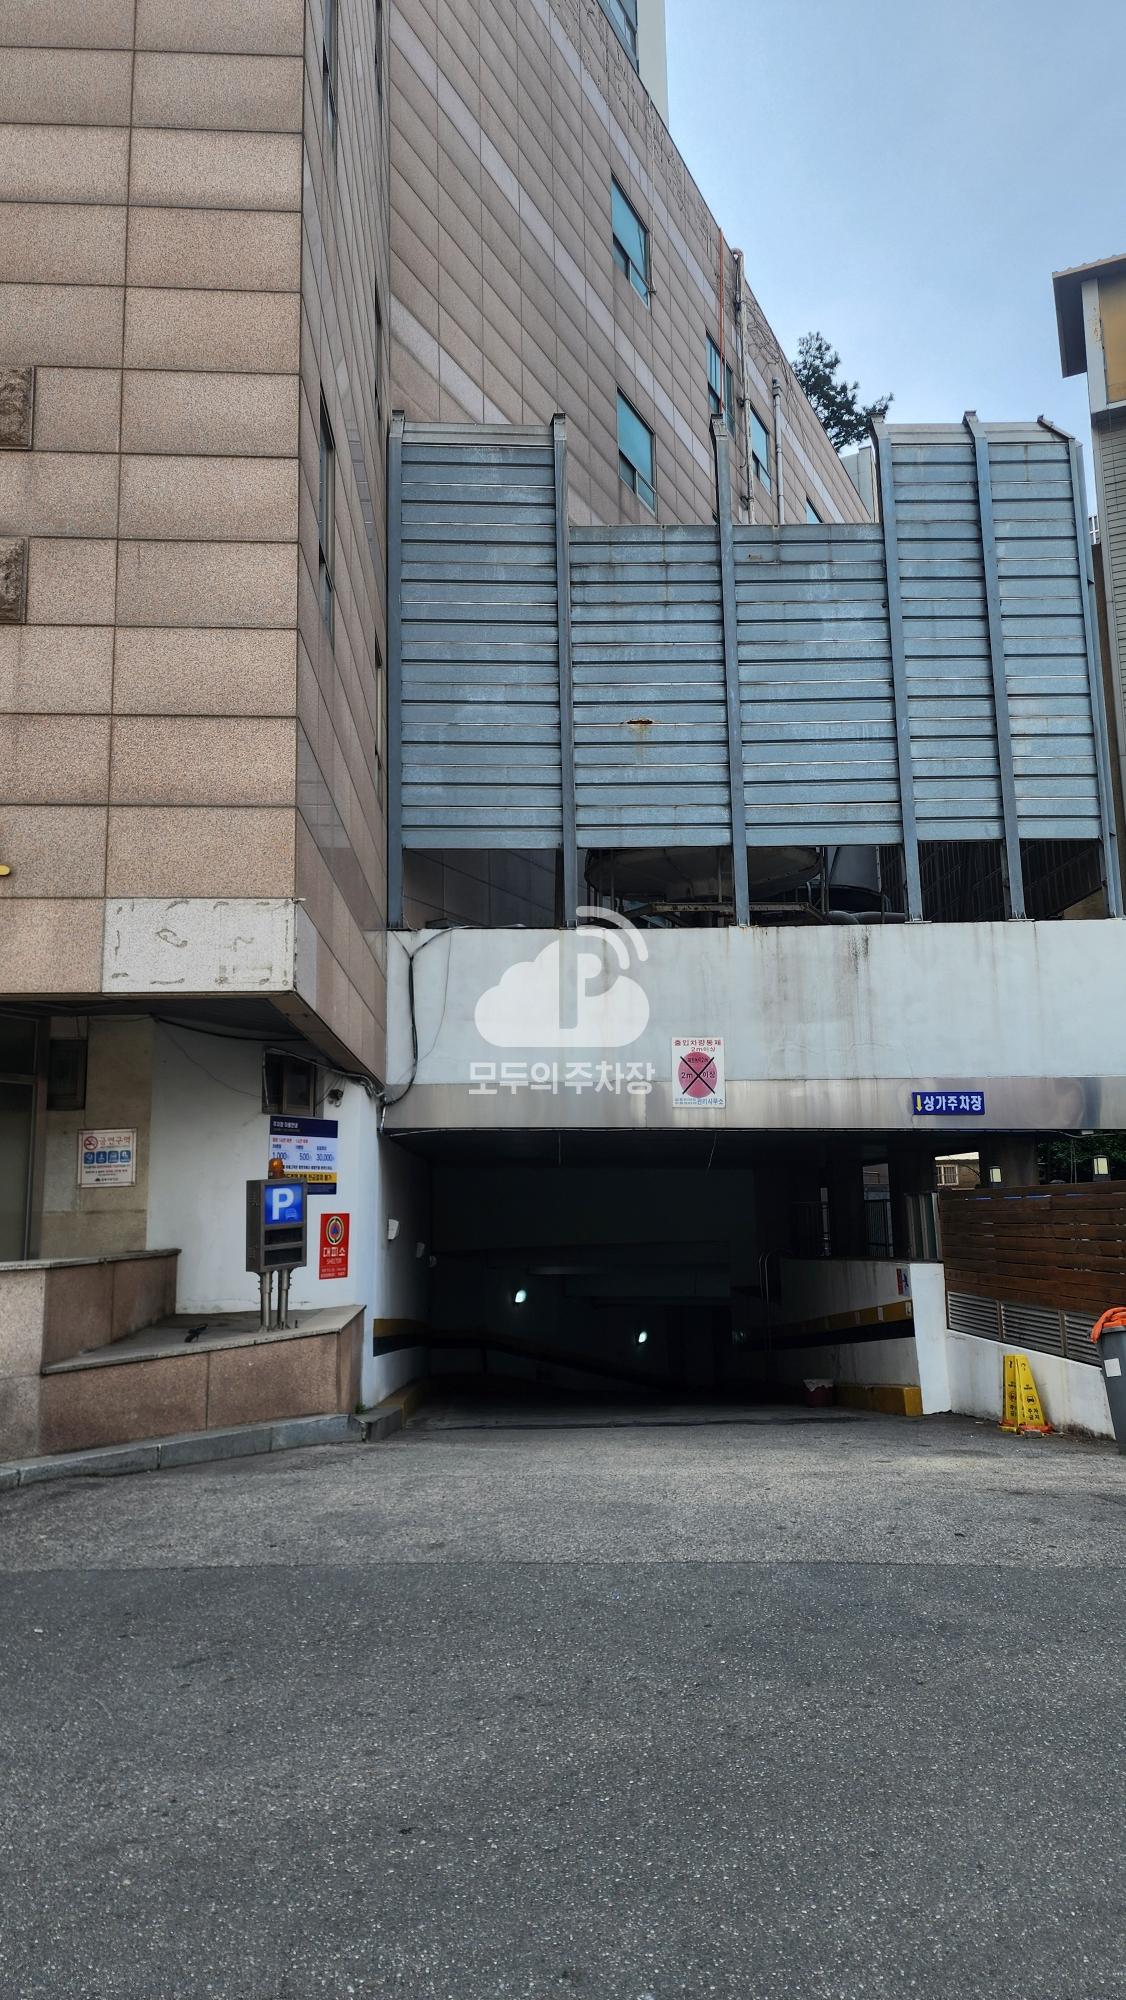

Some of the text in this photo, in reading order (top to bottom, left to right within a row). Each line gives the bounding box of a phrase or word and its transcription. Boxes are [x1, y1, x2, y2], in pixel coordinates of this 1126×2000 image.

[674, 1039, 722, 1047] 출입차량통제
[702, 1071, 716, 1079] 이상
[923, 1094, 982, 1112] 상가주차장
[98, 1136, 131, 1146] 금연구역
[272, 1187, 295, 1221] P
[323, 1246, 346, 1258] 대피소
